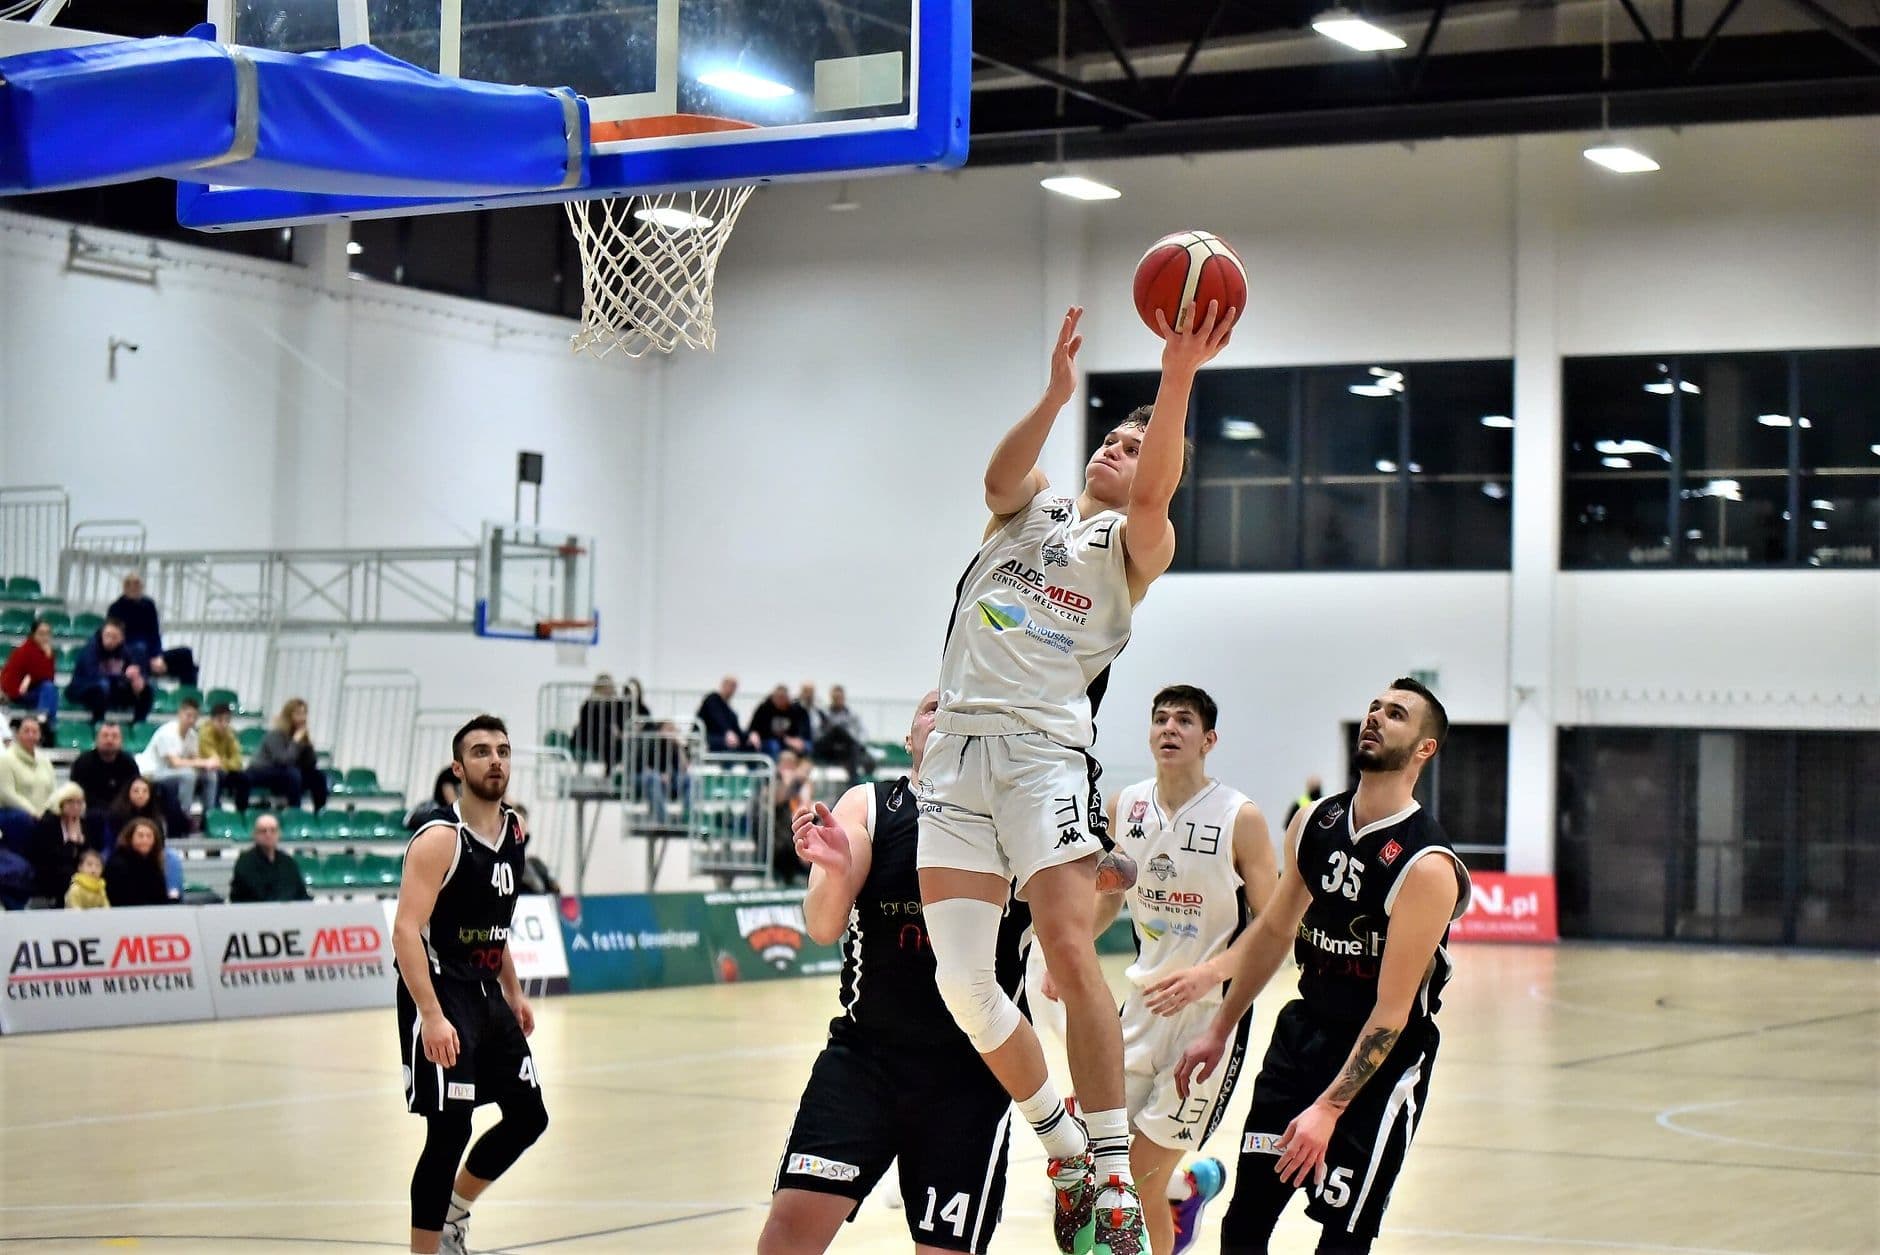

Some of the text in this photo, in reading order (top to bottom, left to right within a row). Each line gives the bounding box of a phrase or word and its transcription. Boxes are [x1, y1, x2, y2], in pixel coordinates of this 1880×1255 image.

[992, 573, 1031, 595] CENTRUM
[1000, 559, 1092, 610] ALDE MED
[1180, 822, 1222, 855] 13
[491, 862, 514, 897] 40
[1321, 850, 1365, 901] 35
[1168, 891, 1203, 904] MED
[10, 933, 192, 974] ALDE MED
[222, 925, 382, 963] ALDE MED
[7, 972, 195, 1000] CENTRUM MEDYCZNE
[220, 960, 385, 988] CENTRUM MEDYCZNE
[519, 1055, 541, 1088] 4
[918, 1186, 970, 1238] 14
